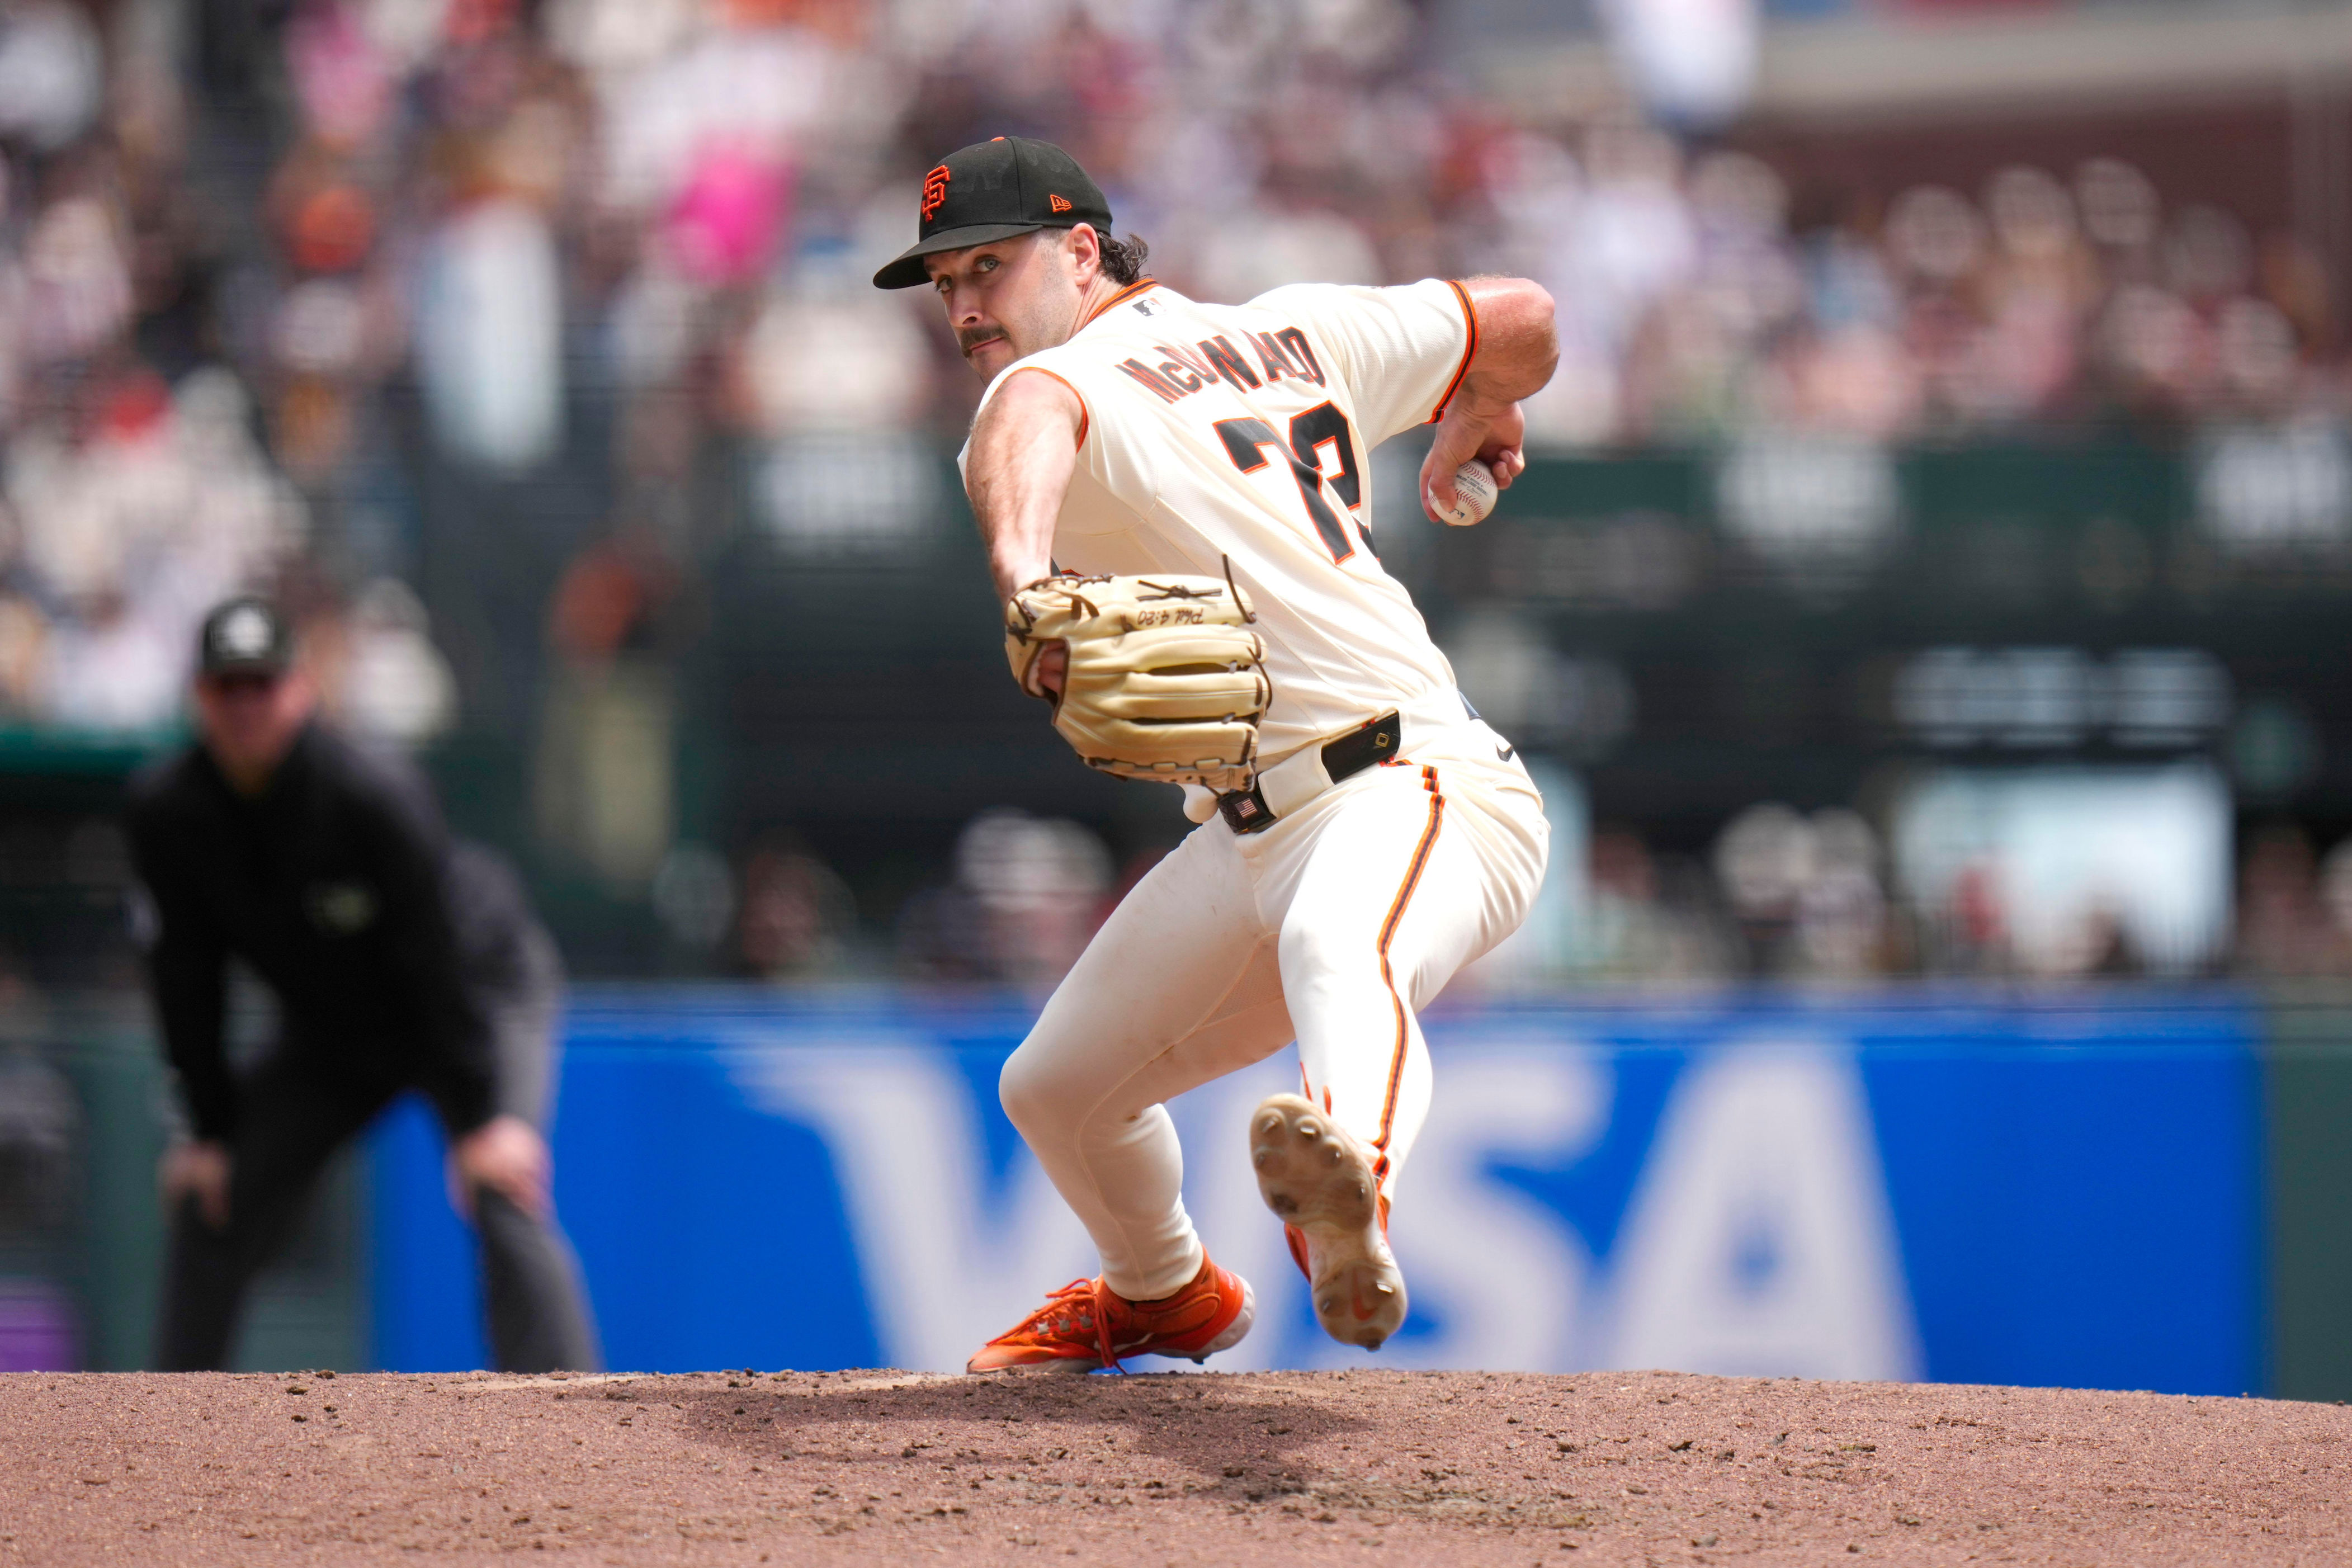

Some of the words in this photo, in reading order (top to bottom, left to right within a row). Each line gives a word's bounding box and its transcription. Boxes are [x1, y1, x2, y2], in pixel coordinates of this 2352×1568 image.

[1114, 326, 1326, 404] McDNALD
[1212, 399, 1381, 566] 72
[733, 1041, 1921, 1380] VISA
